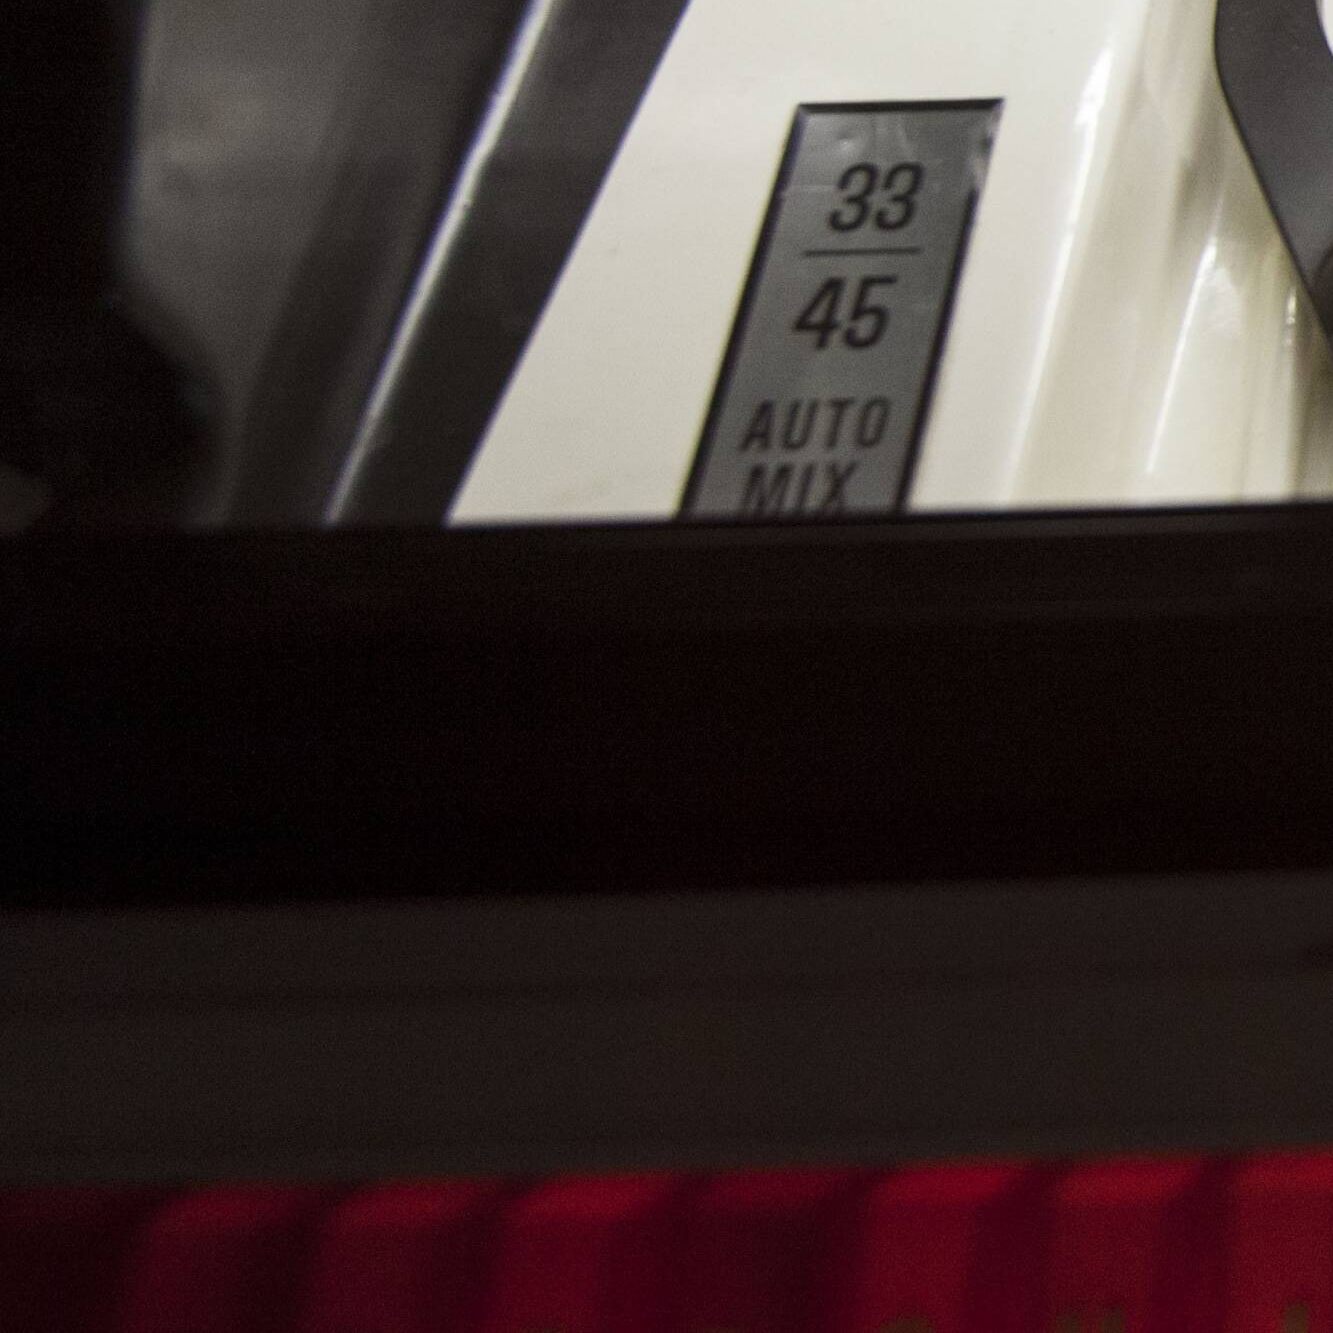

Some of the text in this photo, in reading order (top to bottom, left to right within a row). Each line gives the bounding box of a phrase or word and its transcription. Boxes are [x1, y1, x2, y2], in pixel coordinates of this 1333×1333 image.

[828, 163, 922, 232] 33
[794, 276, 898, 350] 45
[742, 398, 888, 451] AUTO
[741, 460, 857, 518] MIX
